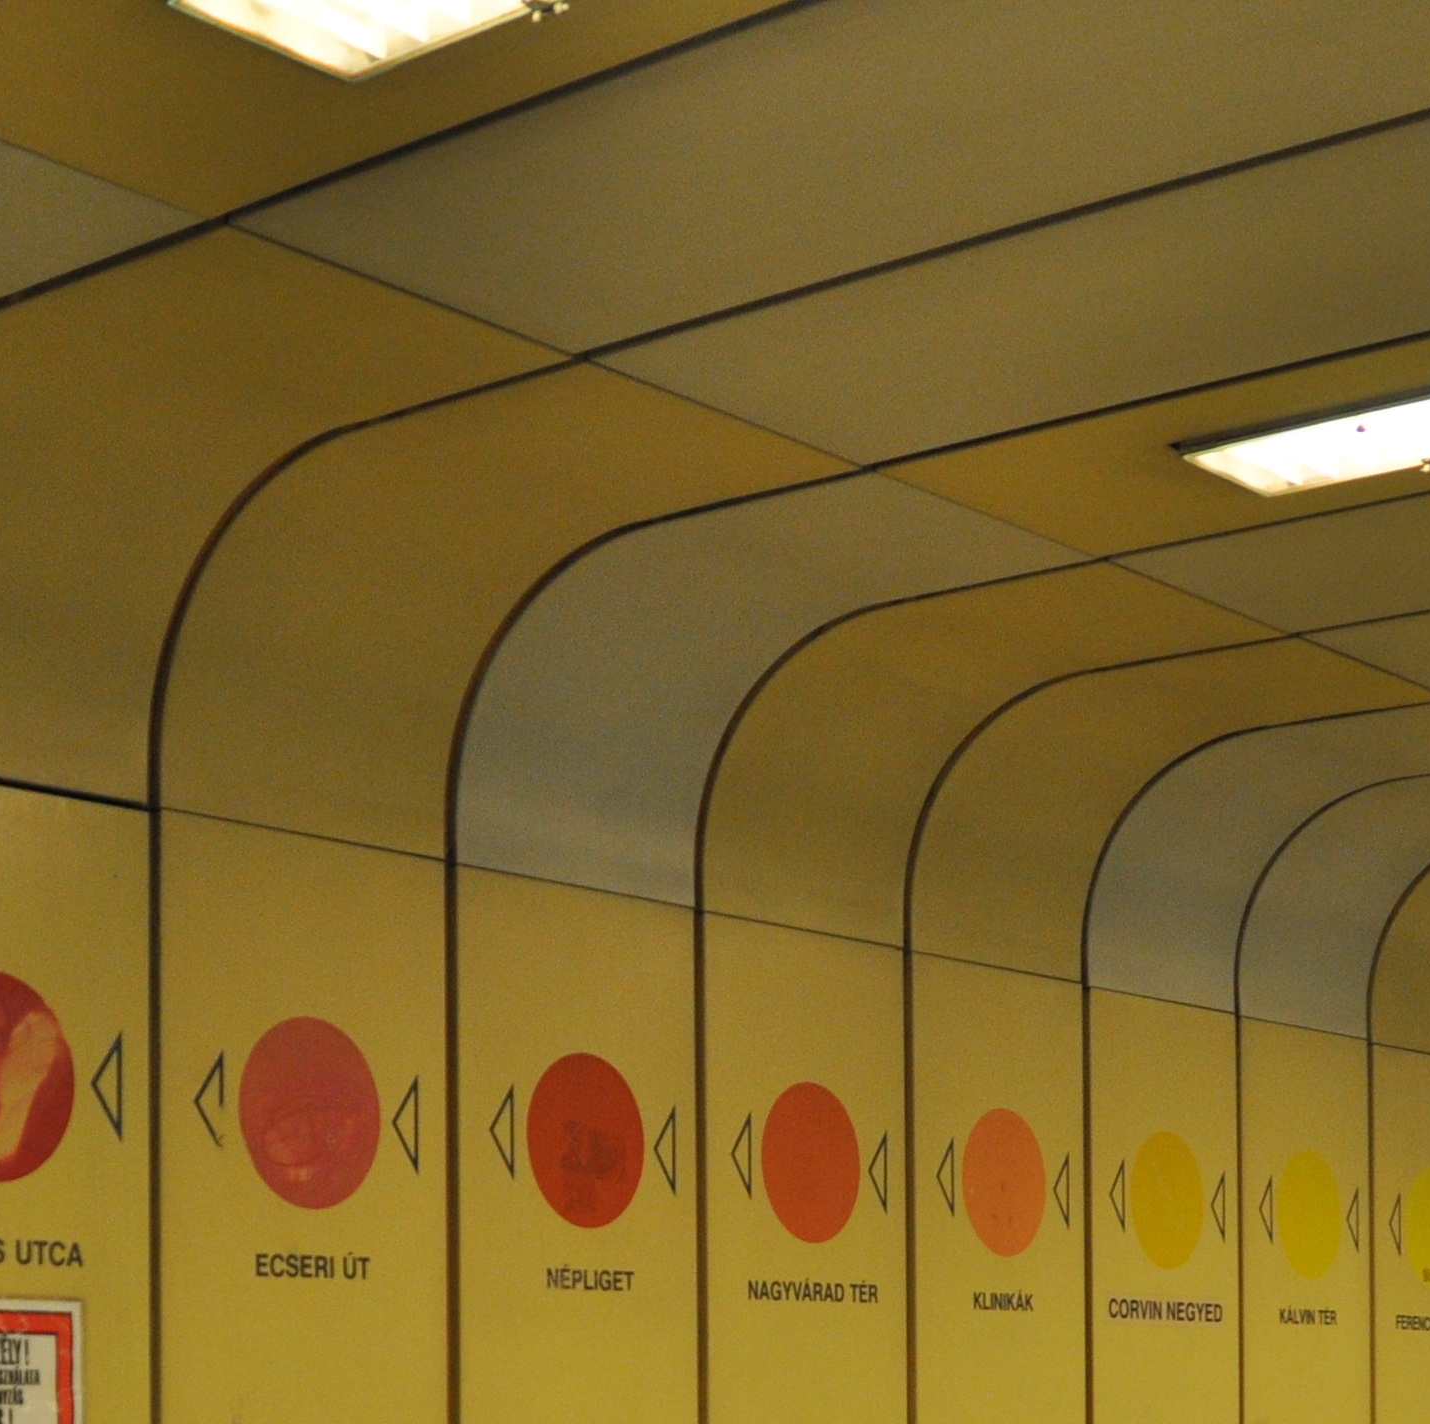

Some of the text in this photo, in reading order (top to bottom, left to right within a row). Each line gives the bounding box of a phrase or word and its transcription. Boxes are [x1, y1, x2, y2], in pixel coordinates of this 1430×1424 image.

[15, 1238, 83, 1267] UTCA
[255, 1251, 370, 1280] ECSERI ÚT
[546, 1263, 635, 1291] NÉPLIGET
[747, 1277, 878, 1304] NAGYVÁRAD TÉR
[973, 1289, 1034, 1312] KLINIKÁK
[1109, 1298, 1223, 1323] CORVIN NEGYED
[1279, 1305, 1337, 1326] KÁLVIN TÉR
